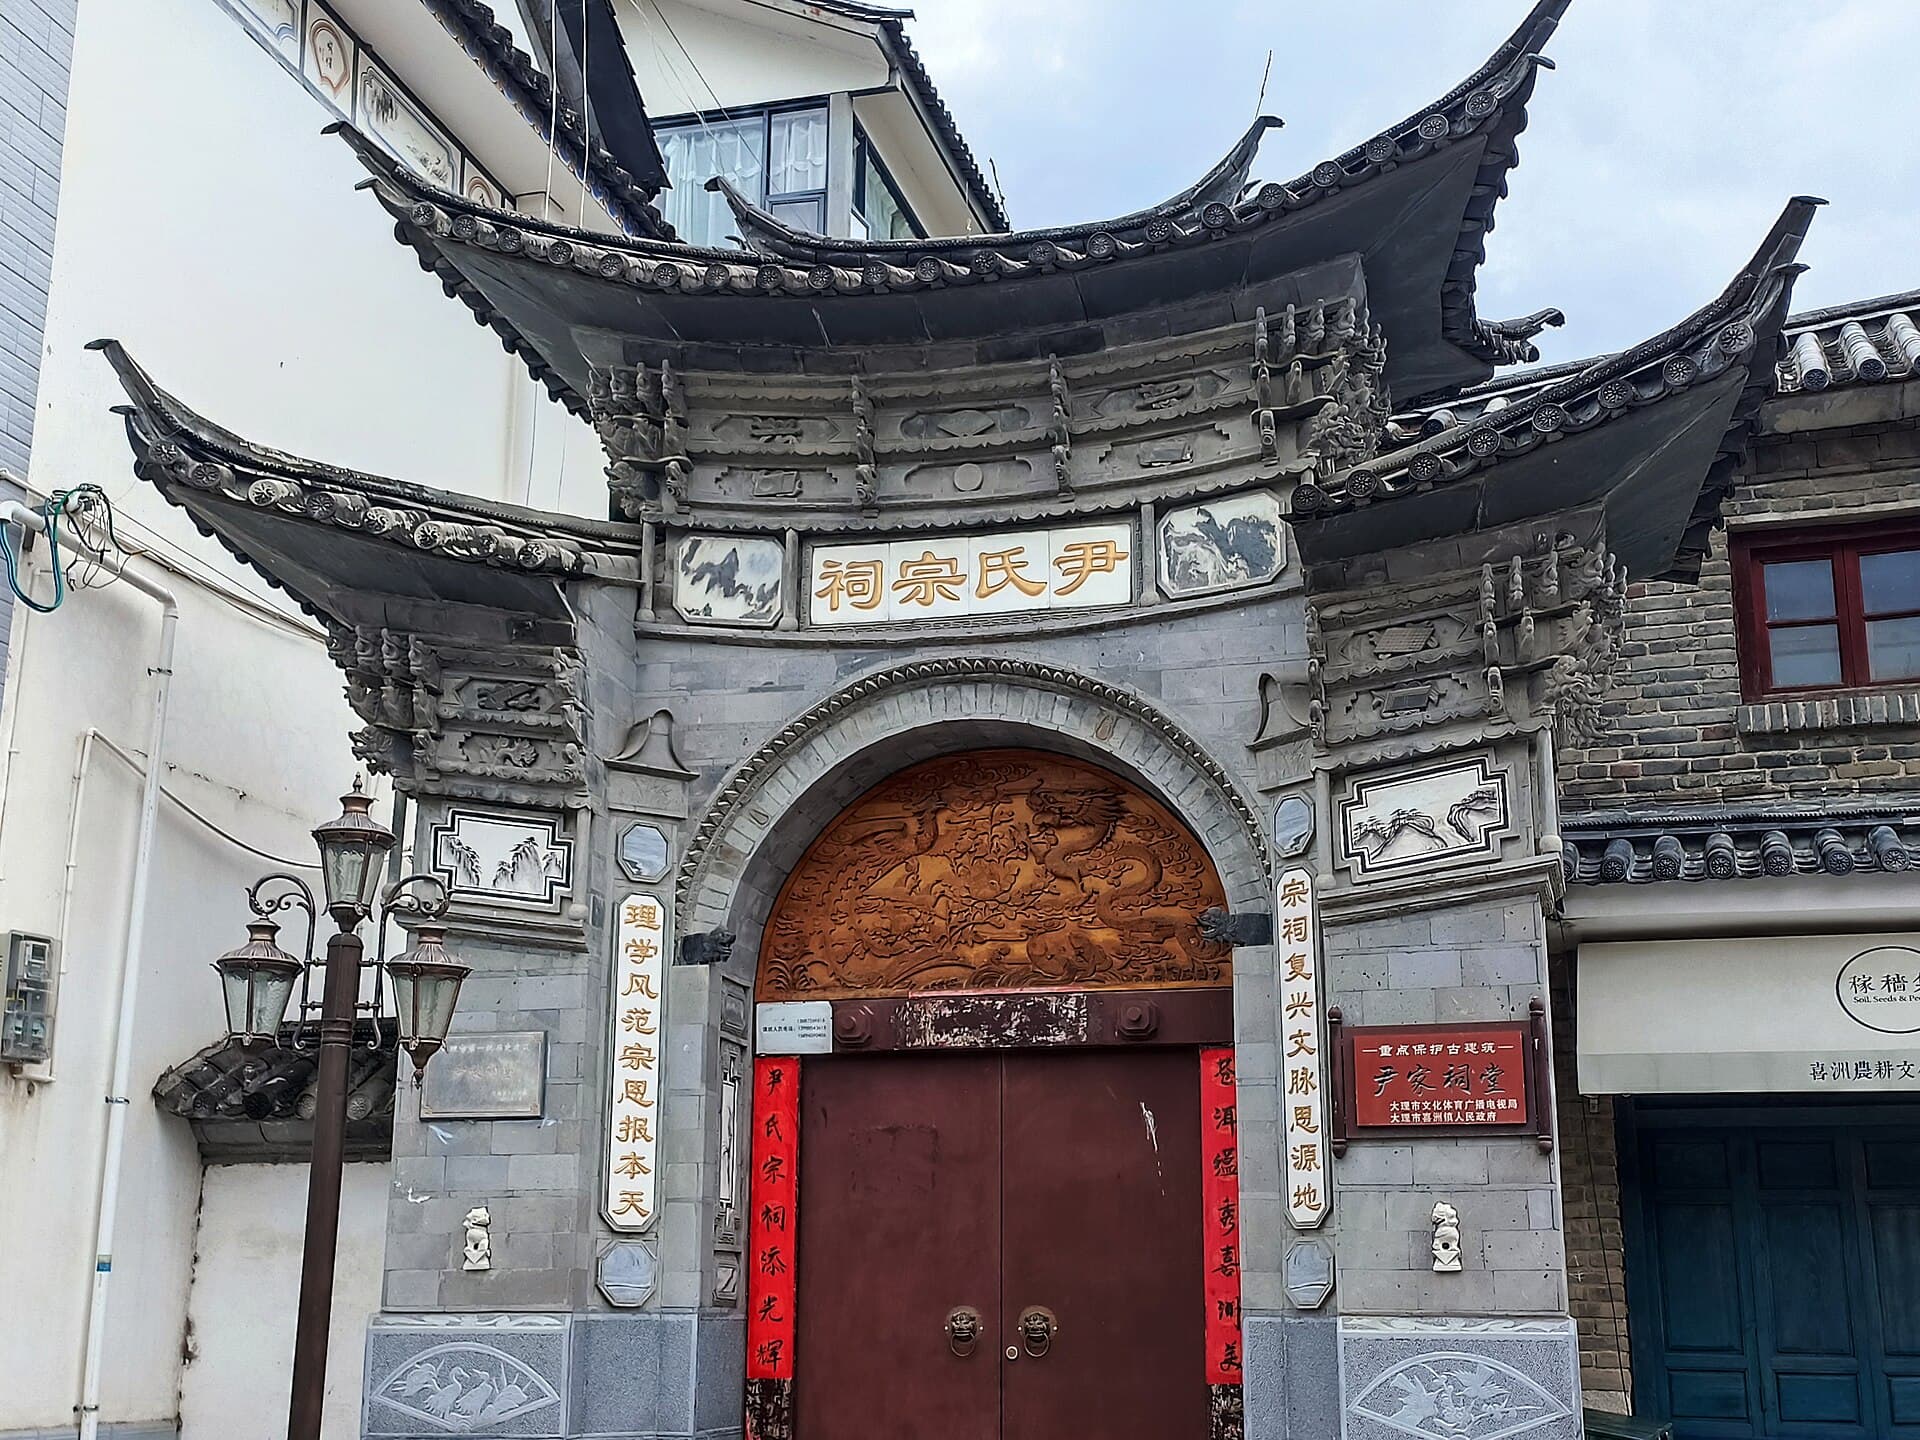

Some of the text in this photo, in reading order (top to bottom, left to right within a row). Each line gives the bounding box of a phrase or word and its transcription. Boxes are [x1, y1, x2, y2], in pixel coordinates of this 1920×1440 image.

[1873, 994, 1897, 1003] Seeds
[1898, 994, 1907, 1002] &
[1280, 878, 1322, 1212] 宗祠复兴文脉思源地
[611, 904, 661, 1218] 理学风范宗恩报本天
[1809, 1060, 1920, 1080] 喜洲農耕文
[1373, 1062, 1506, 1097] 尹家祠堂
[1389, 1099, 1518, 1112] 大理市文化体育广播电视局
[1390, 1111, 1497, 1123] 大理市喜洲镇人民政府
